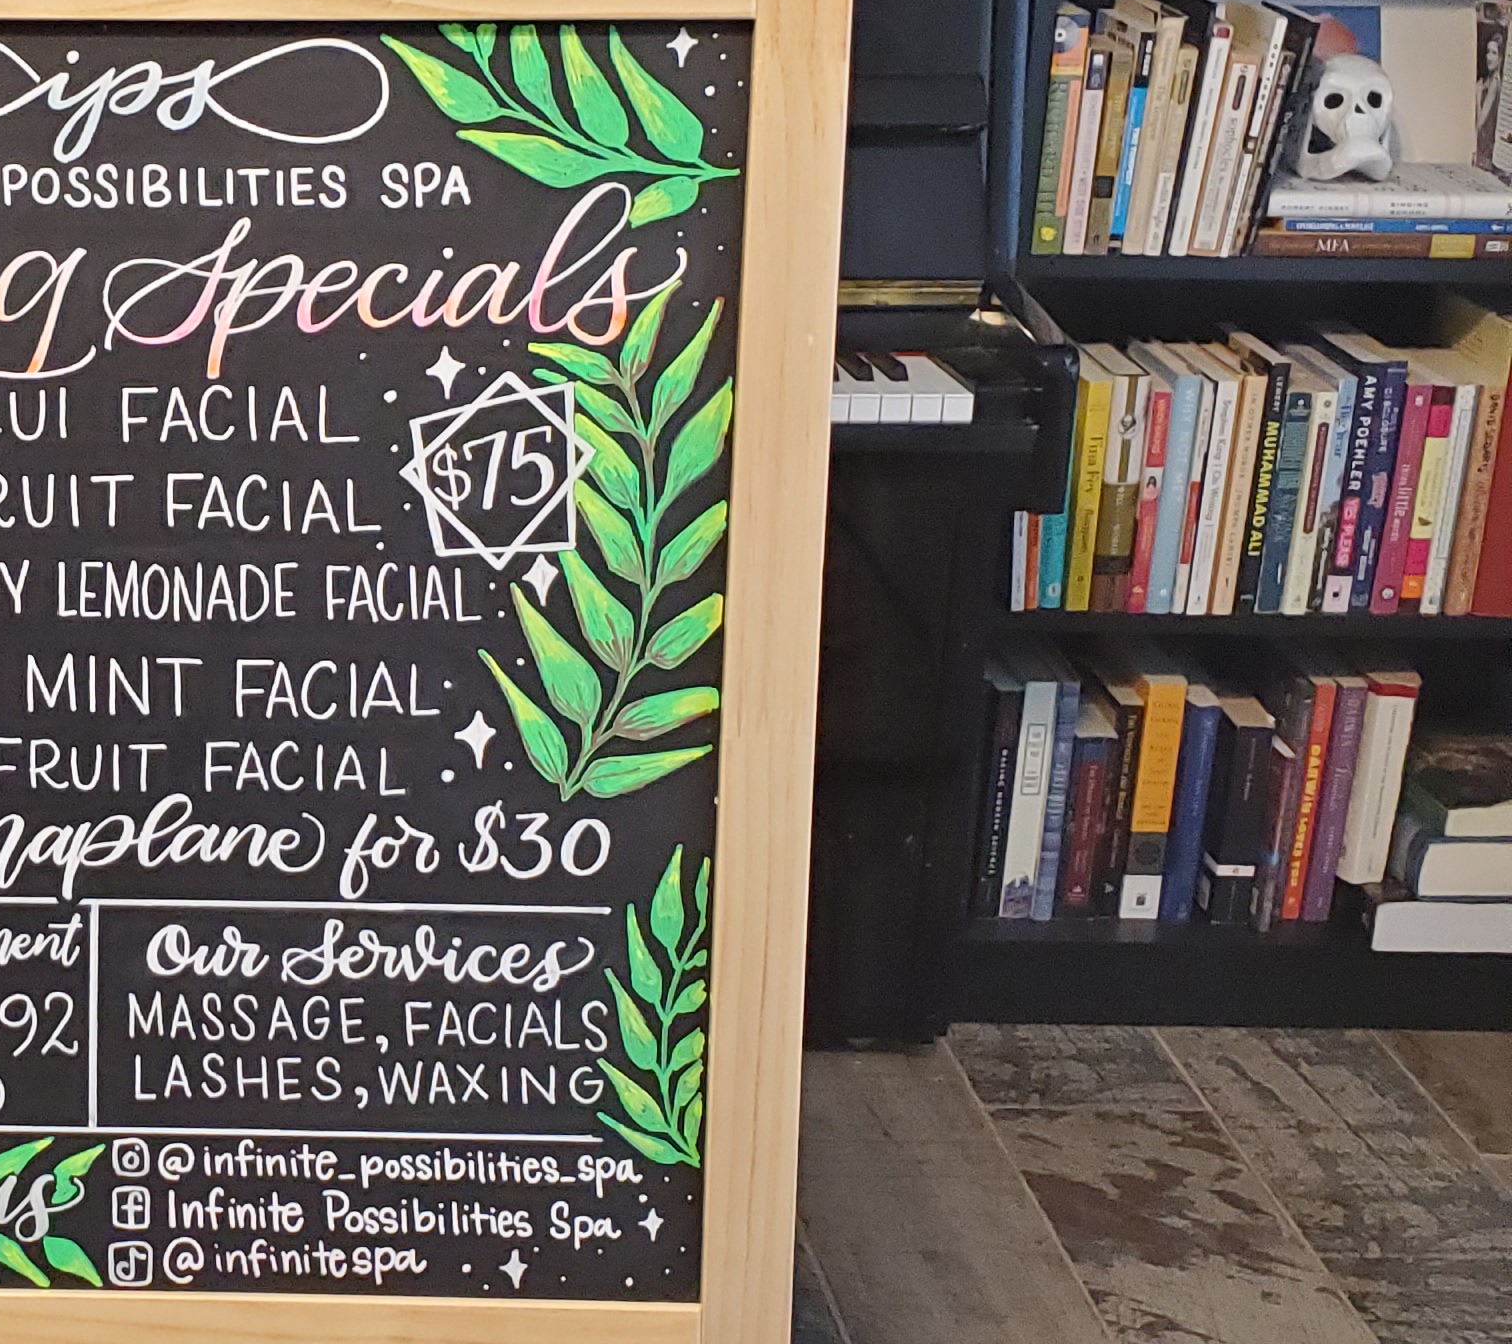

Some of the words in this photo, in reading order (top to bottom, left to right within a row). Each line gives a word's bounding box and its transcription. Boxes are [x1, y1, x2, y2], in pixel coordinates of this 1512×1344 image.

[2, 162, 348, 209] POSSIBILITIES
[379, 161, 472, 209] SPA
[1316, 238, 1350, 253] MFA
[103, 181, 687, 379] Specials
[121, 384, 361, 444] FACIAL
[1181, 389, 1194, 423] WHY
[1360, 375, 1377, 411] AMY
[1487, 394, 1500, 426] DAVID
[431, 424, 557, 512] $75
[1175, 431, 1190, 465] NOT
[1213, 439, 1228, 461] King
[1253, 421, 1280, 528] MUHAMMAD
[1348, 417, 1372, 491] POEHLER
[165, 472, 382, 535] FACIAL
[1394, 487, 1413, 518] little
[1248, 530, 1262, 556] ALI
[1336, 524, 1356, 568] PLEASE
[56, 559, 299, 623] LEMONADE
[325, 561, 483, 624] FACIAL
[26, 652, 204, 717] MINT
[234, 657, 441, 721] FACIAL
[203, 739, 407, 797] FACIAL
[1300, 745, 1322, 814] DARWIN
[338, 813, 440, 900] for
[458, 800, 612, 880] $30
[145, 922, 270, 978] Our
[280, 917, 596, 993] Services
[127, 989, 390, 1055] MASSAGE,
[403, 999, 610, 1054] FACIALS
[375, 1058, 607, 1107] WAXING
[167, 1187, 306, 1234] Infinite
[320, 1188, 534, 1239] Possibilities
[548, 1199, 624, 1251] Spa
